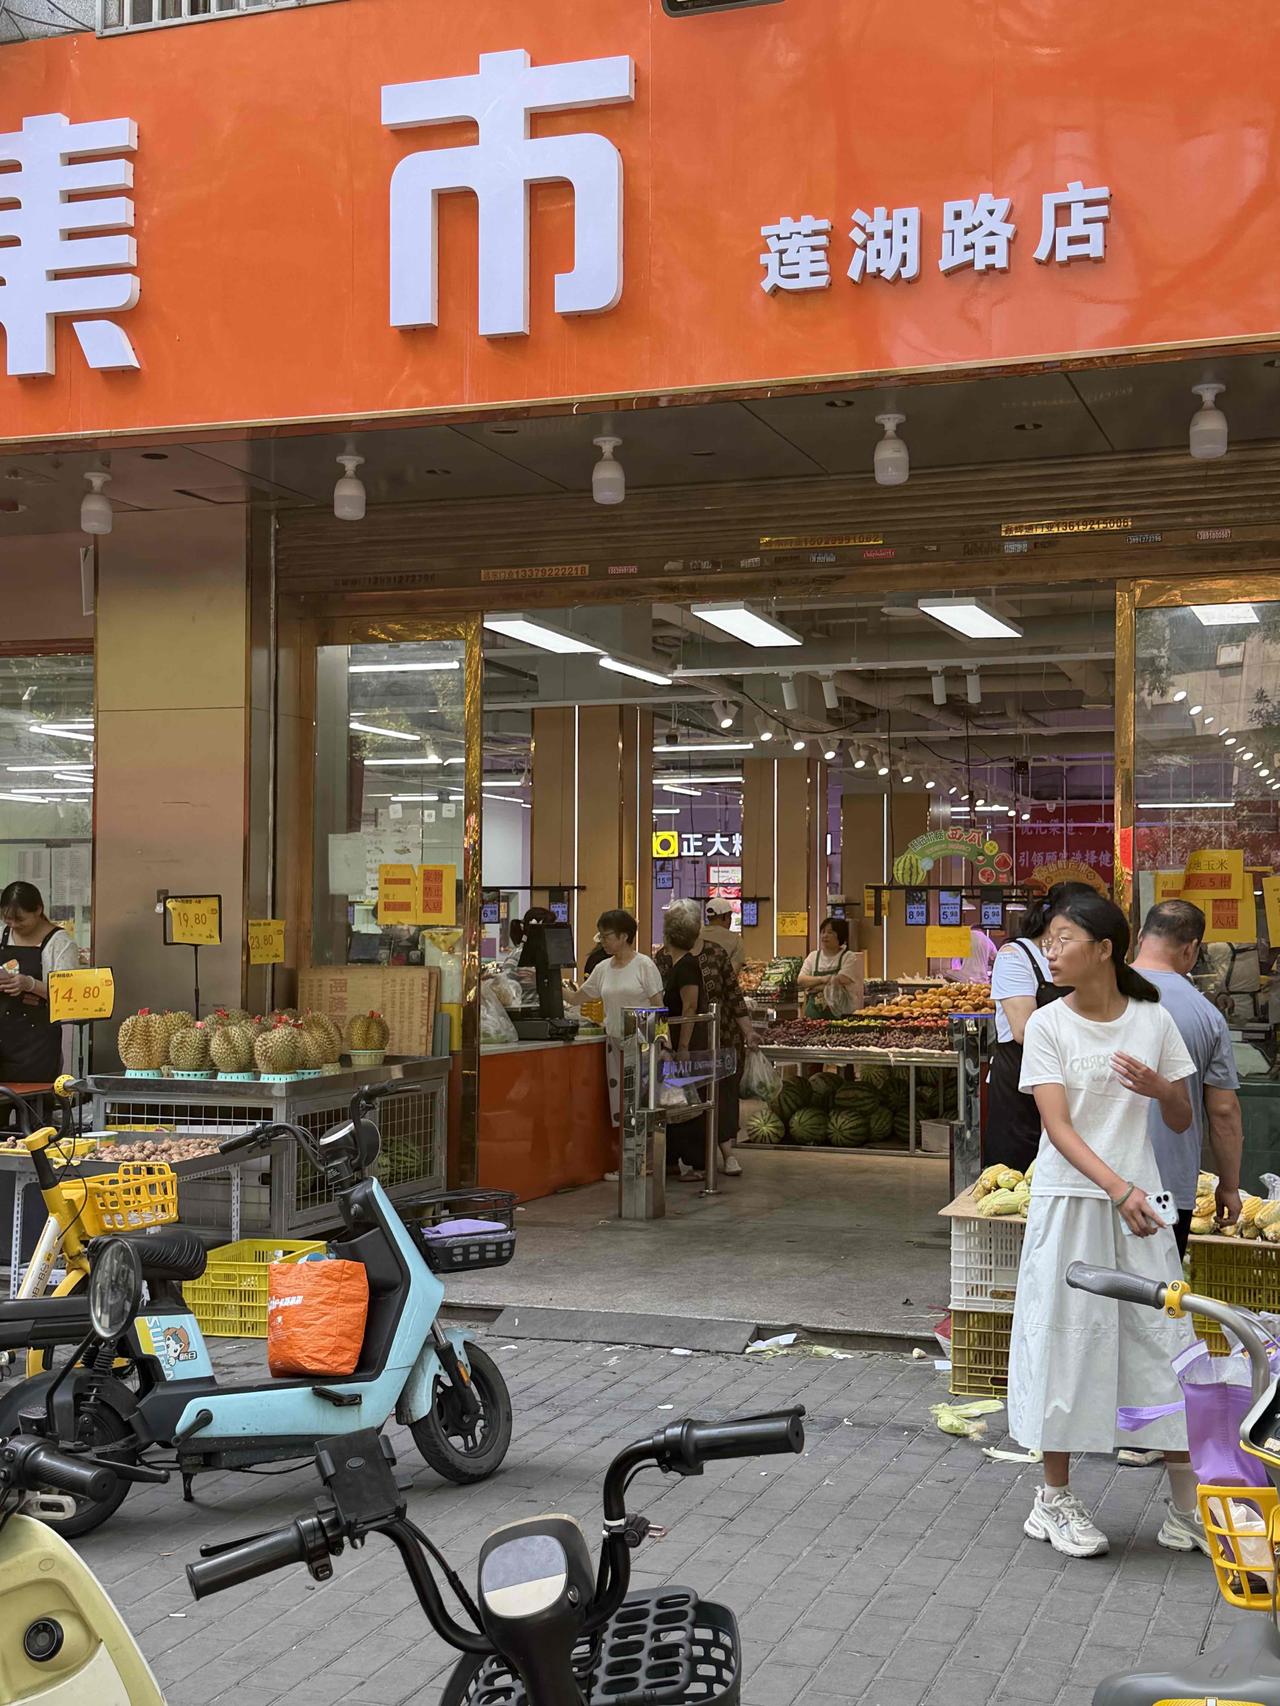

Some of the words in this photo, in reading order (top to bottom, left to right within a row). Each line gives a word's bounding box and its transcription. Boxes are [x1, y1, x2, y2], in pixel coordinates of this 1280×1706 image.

[760, 181, 1112, 295] 莲湖路店
[178, 912, 207, 928] 19.80
[250, 934, 274, 950] 23.80
[53, 985, 100, 1004] 14.80
